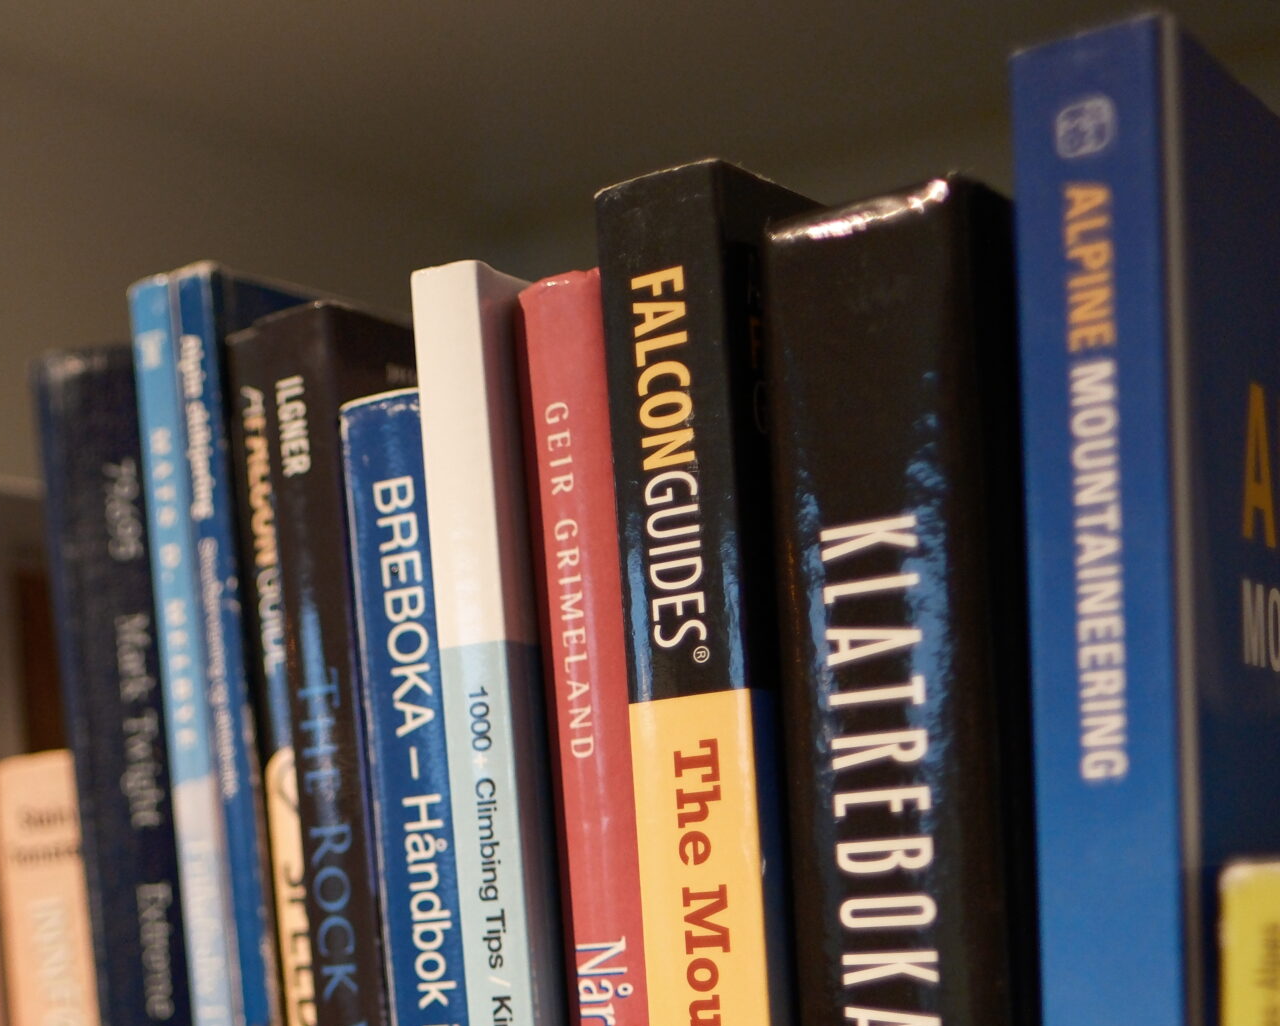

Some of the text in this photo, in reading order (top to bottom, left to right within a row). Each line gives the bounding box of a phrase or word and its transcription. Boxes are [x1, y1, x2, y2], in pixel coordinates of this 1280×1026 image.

[274, 373, 312, 478] ILGNER
[1064, 183, 1130, 783] ALPINE MOUNTAINEERING
[371, 474, 436, 739] BREBOKA
[543, 400, 596, 761] GEIR GRIMELAND
[115, 612, 157, 702] Mark
[121, 707, 166, 828] Twight
[297, 667, 343, 794] THE
[474, 777, 501, 903] Climbing
[673, 738, 723, 867] The
[135, 881, 176, 1021] Extreme
[308, 822, 360, 1001] ROCK
[401, 792, 458, 1012] Håndbok
[481, 906, 509, 970] Tips
